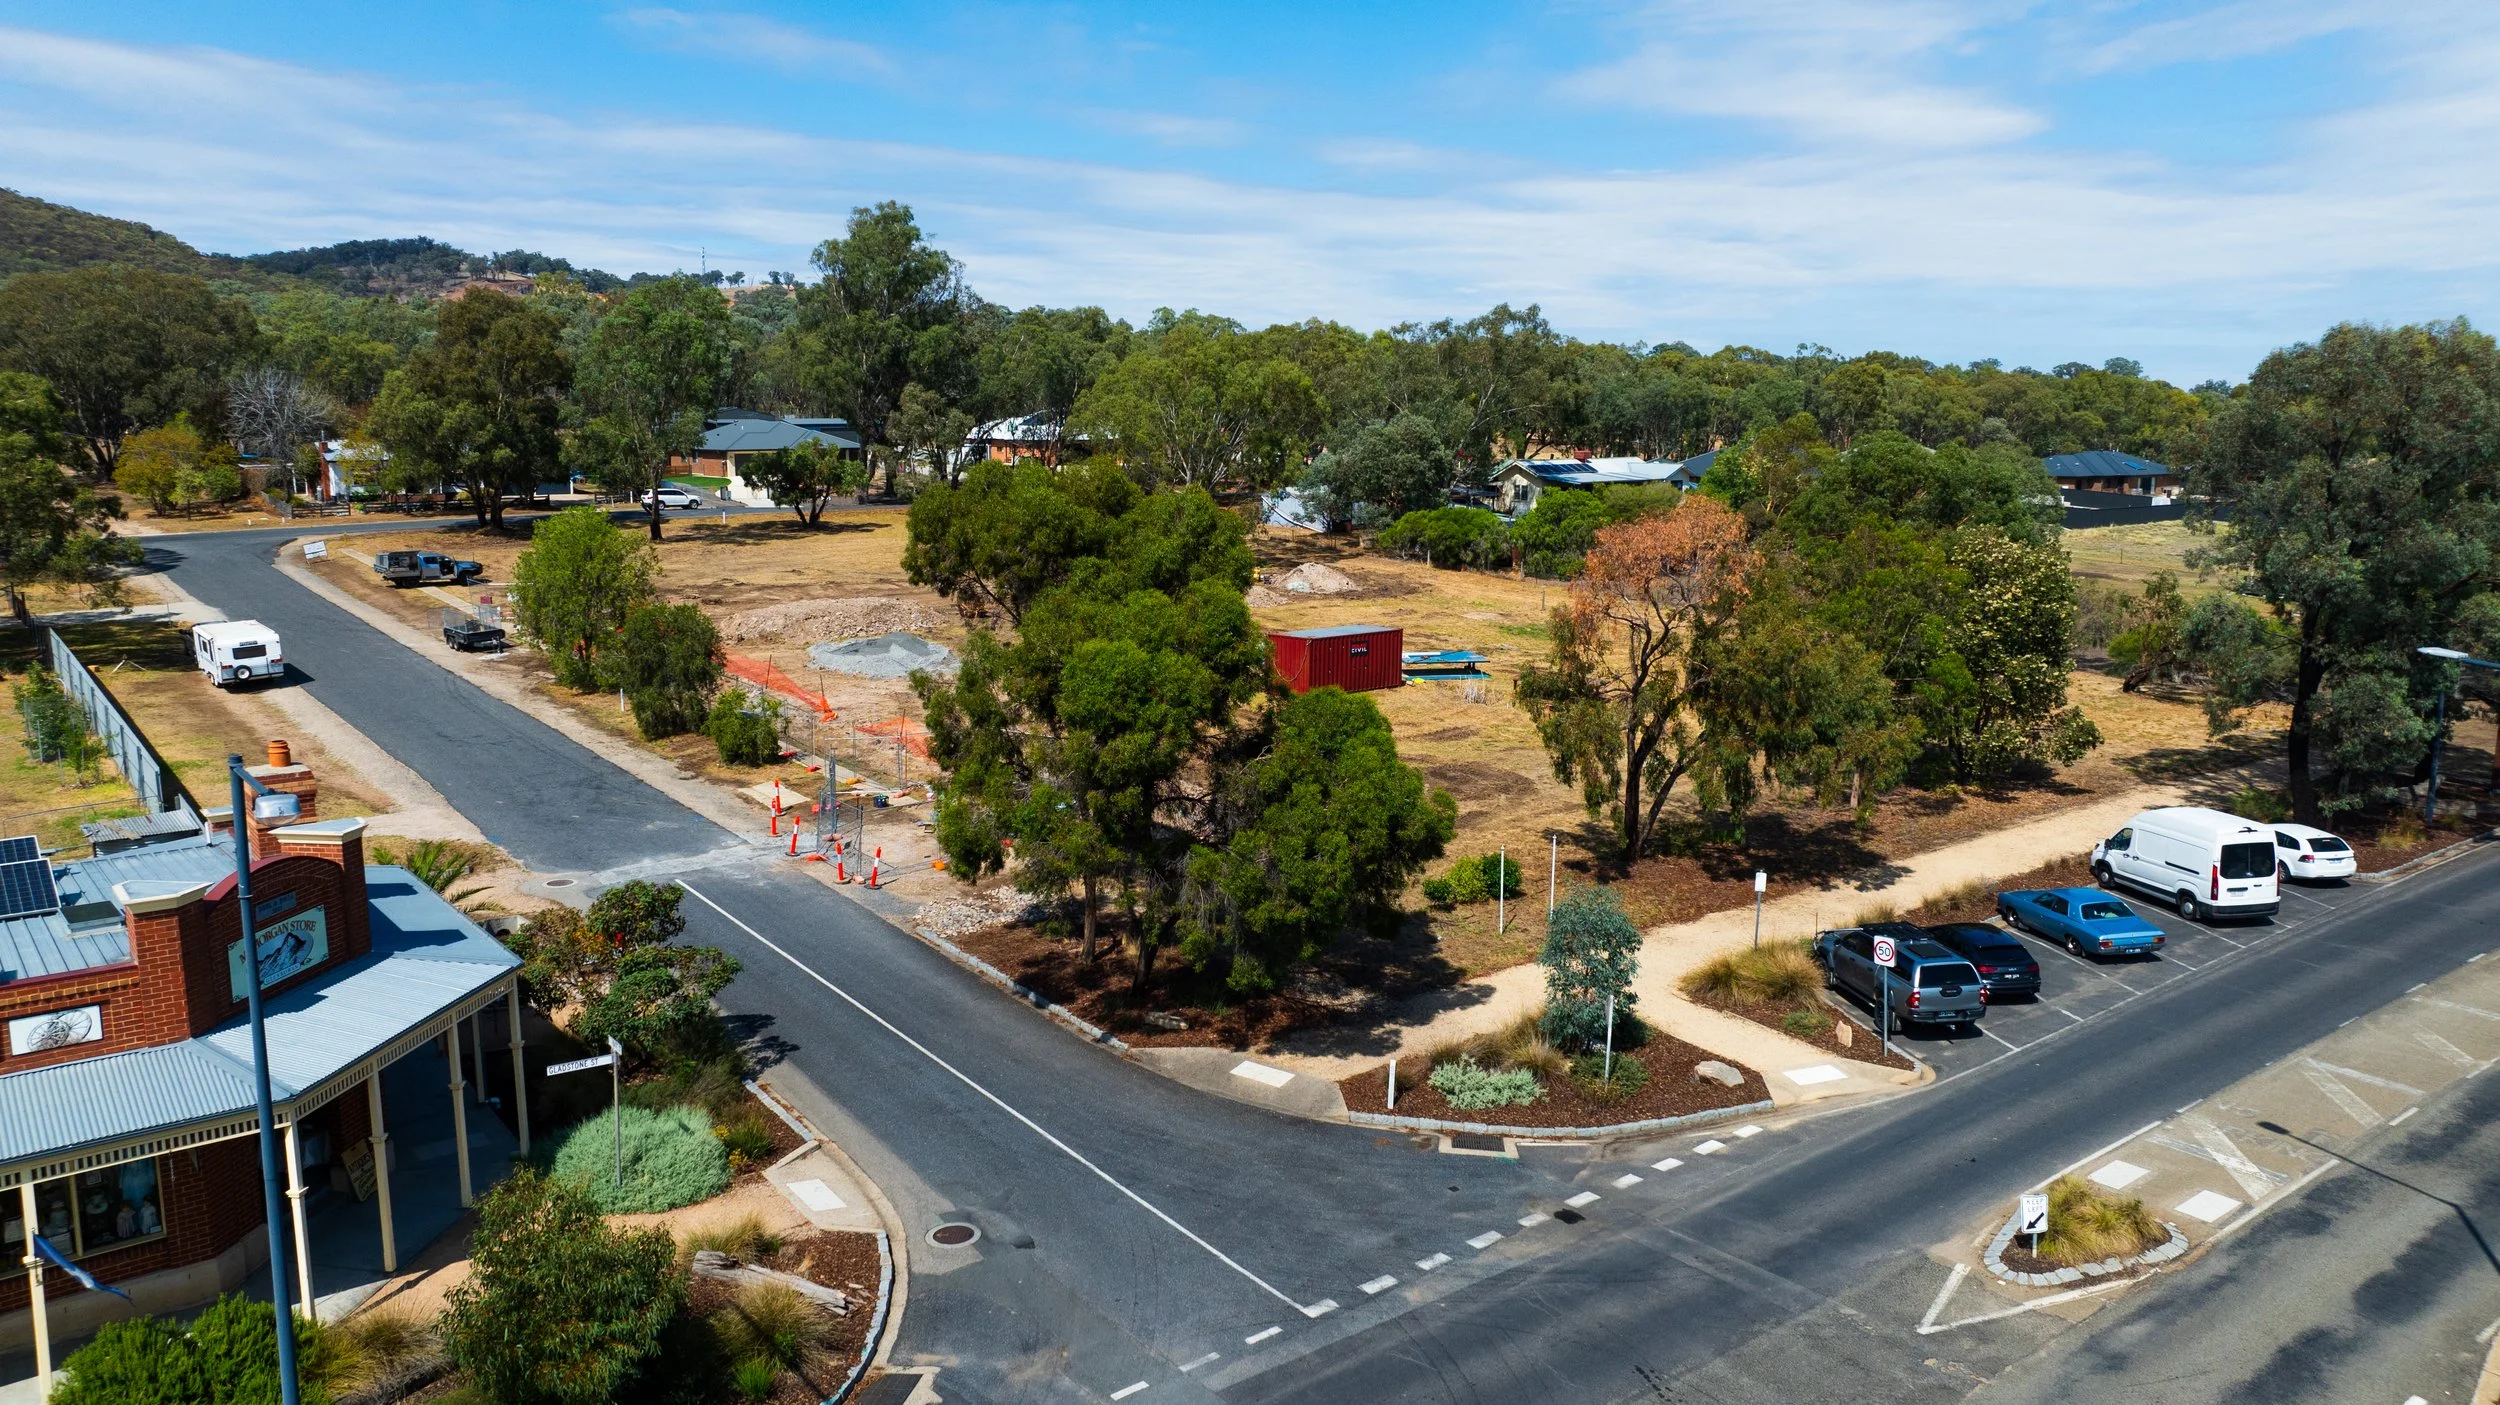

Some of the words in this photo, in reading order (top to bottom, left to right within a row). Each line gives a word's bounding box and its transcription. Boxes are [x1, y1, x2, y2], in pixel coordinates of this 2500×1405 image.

[290, 919, 317, 932] STORE
[1878, 946, 1891, 957] 50
[548, 1060, 588, 1074] GLADSTONE
[591, 1057, 599, 1066] ST
[2027, 1205, 2043, 1213] LEFT
